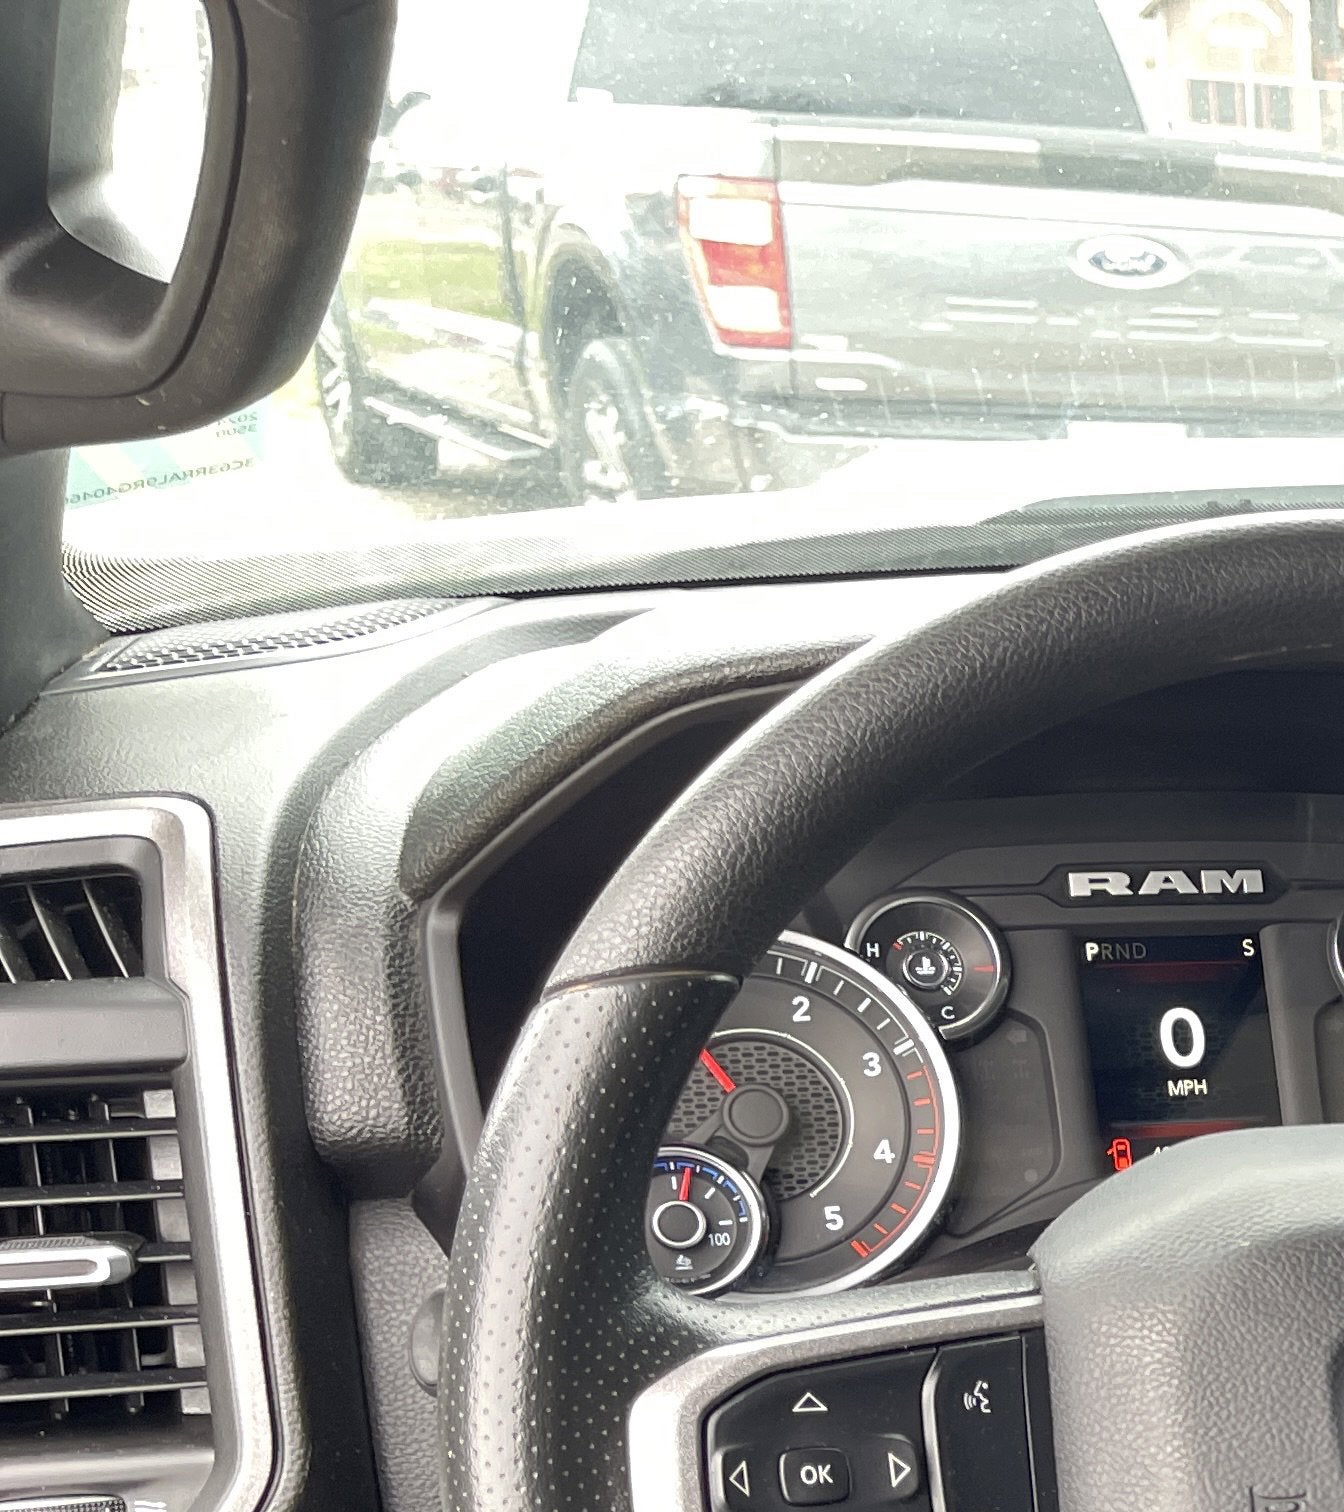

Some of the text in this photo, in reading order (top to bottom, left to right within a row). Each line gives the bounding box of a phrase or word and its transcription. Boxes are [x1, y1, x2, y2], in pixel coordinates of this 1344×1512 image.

[1068, 869, 1264, 897] RAM
[866, 942, 880, 958] H
[792, 995, 811, 1023] 2
[941, 1005, 955, 1020] C
[1159, 1006, 1206, 1068] 0
[863, 1052, 882, 1078] 3
[1168, 1077, 1209, 1098] MPH
[872, 1139, 896, 1164] 4
[824, 1205, 844, 1232] 5
[708, 1232, 731, 1247] 100
[800, 1464, 834, 1485] OK
